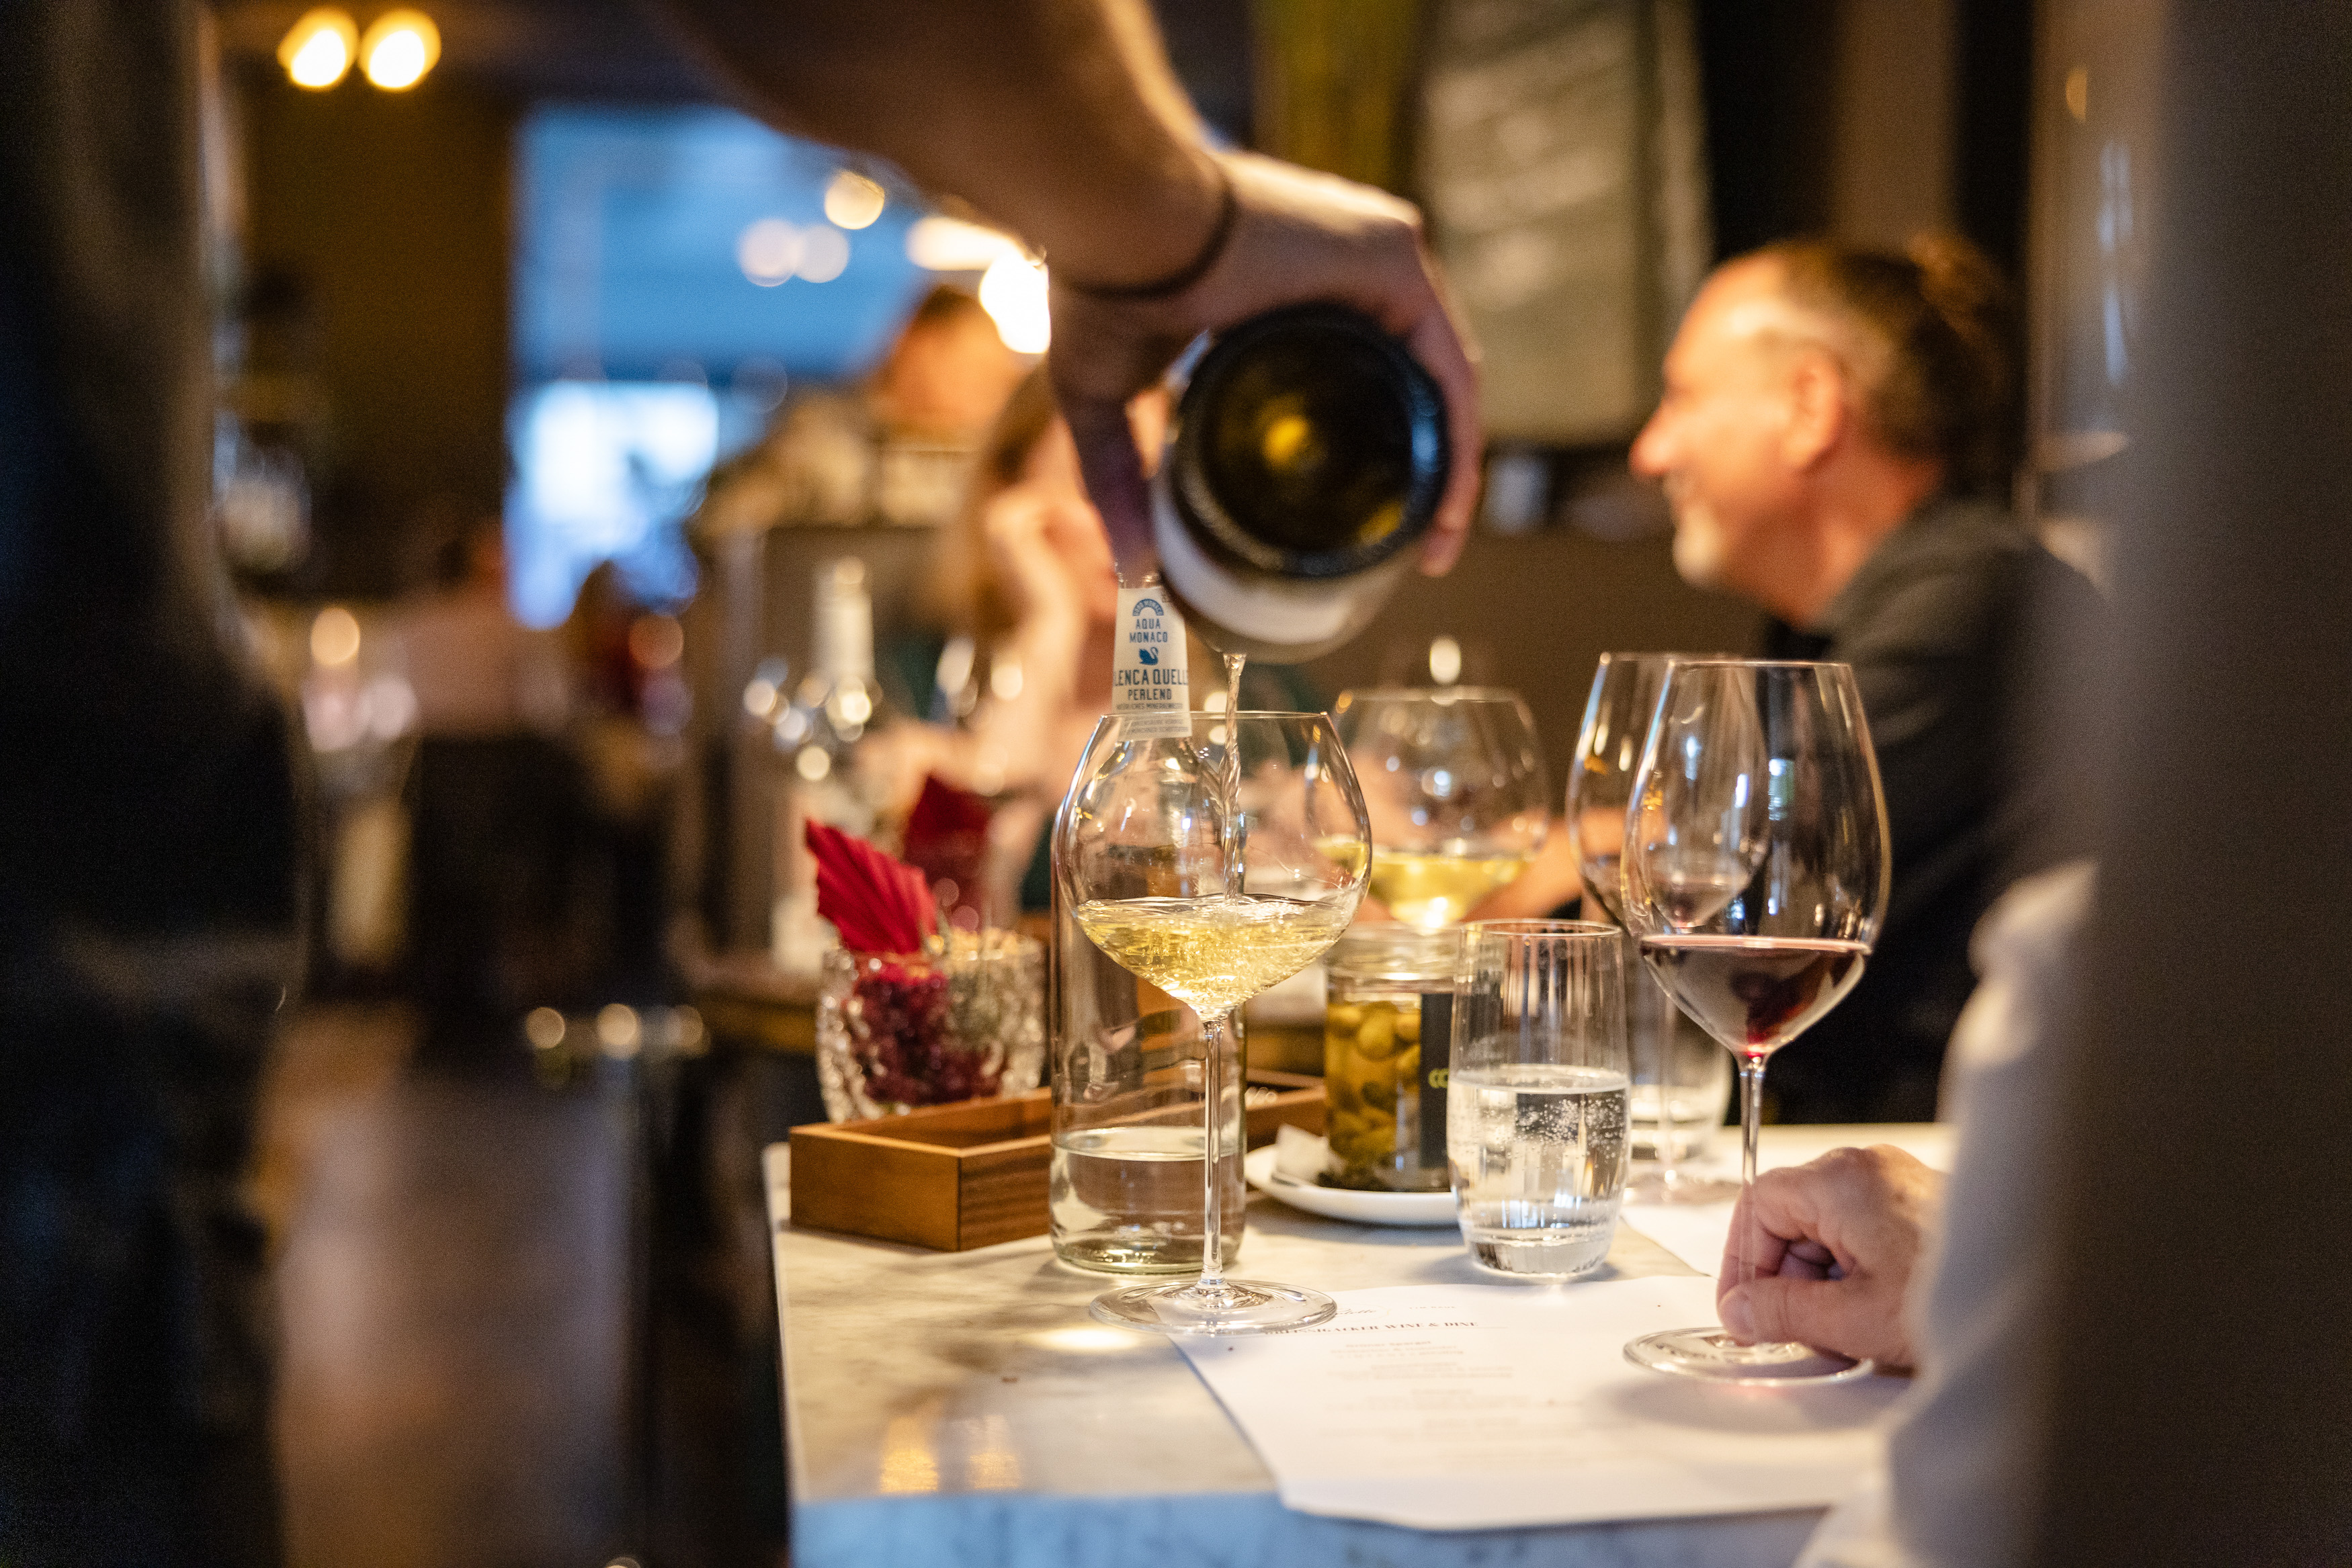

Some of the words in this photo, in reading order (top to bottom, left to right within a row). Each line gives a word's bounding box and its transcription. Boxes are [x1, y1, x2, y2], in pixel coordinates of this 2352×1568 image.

[1136, 618, 1161, 629] AQUA
[1129, 631, 1168, 643] MONACO
[1128, 688, 1172, 701] PERLEND
